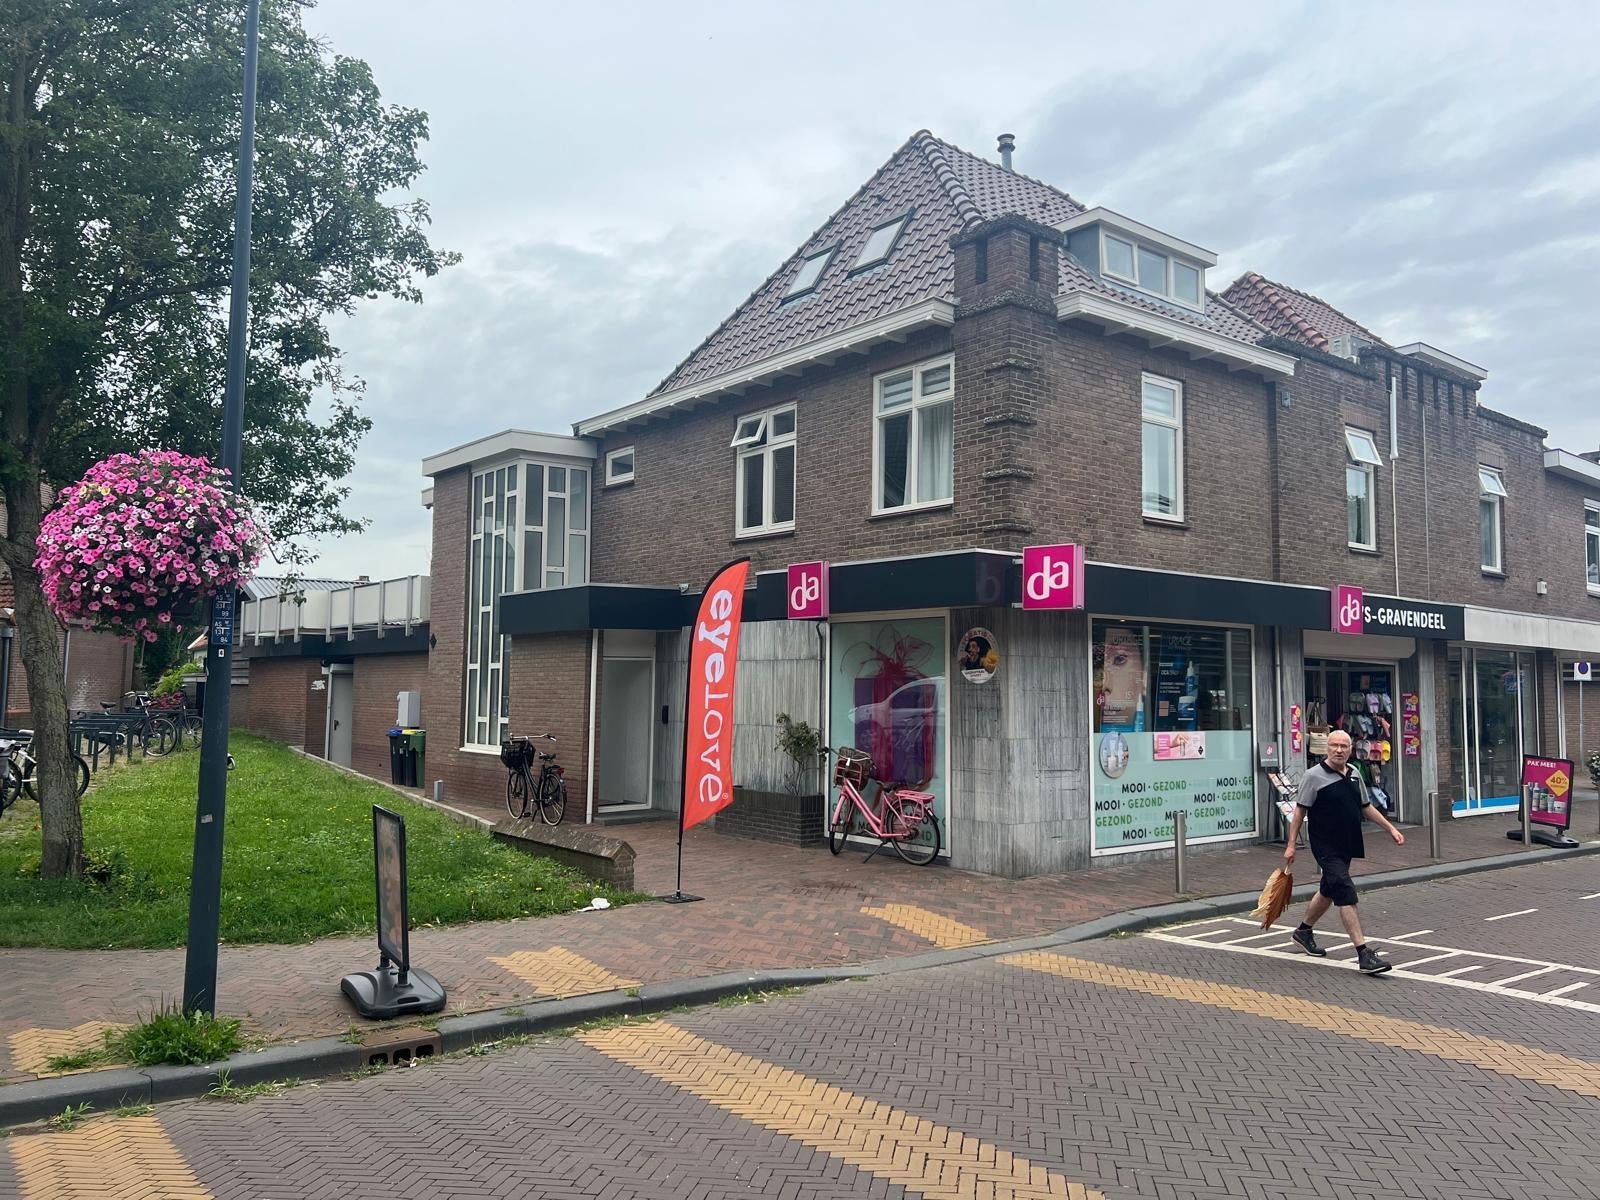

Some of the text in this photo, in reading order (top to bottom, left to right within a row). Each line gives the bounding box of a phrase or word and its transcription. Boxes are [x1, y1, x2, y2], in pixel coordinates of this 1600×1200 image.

[1026, 555, 1070, 601] da
[790, 572, 820, 611] da
[1340, 593, 1360, 627] da
[1121, 780, 1187, 793] MOOI GEZOND
[1216, 777, 1238, 787] MOOI
[1193, 790, 1252, 803] MOOI GEZOND
[1095, 797, 1163, 811] MOOI GEZOND
[1194, 806, 1226, 818] GEZOND
[1095, 814, 1132, 828] GEZOND
[1217, 819, 1238, 830] MOOI
[1122, 827, 1147, 840] MOOI
